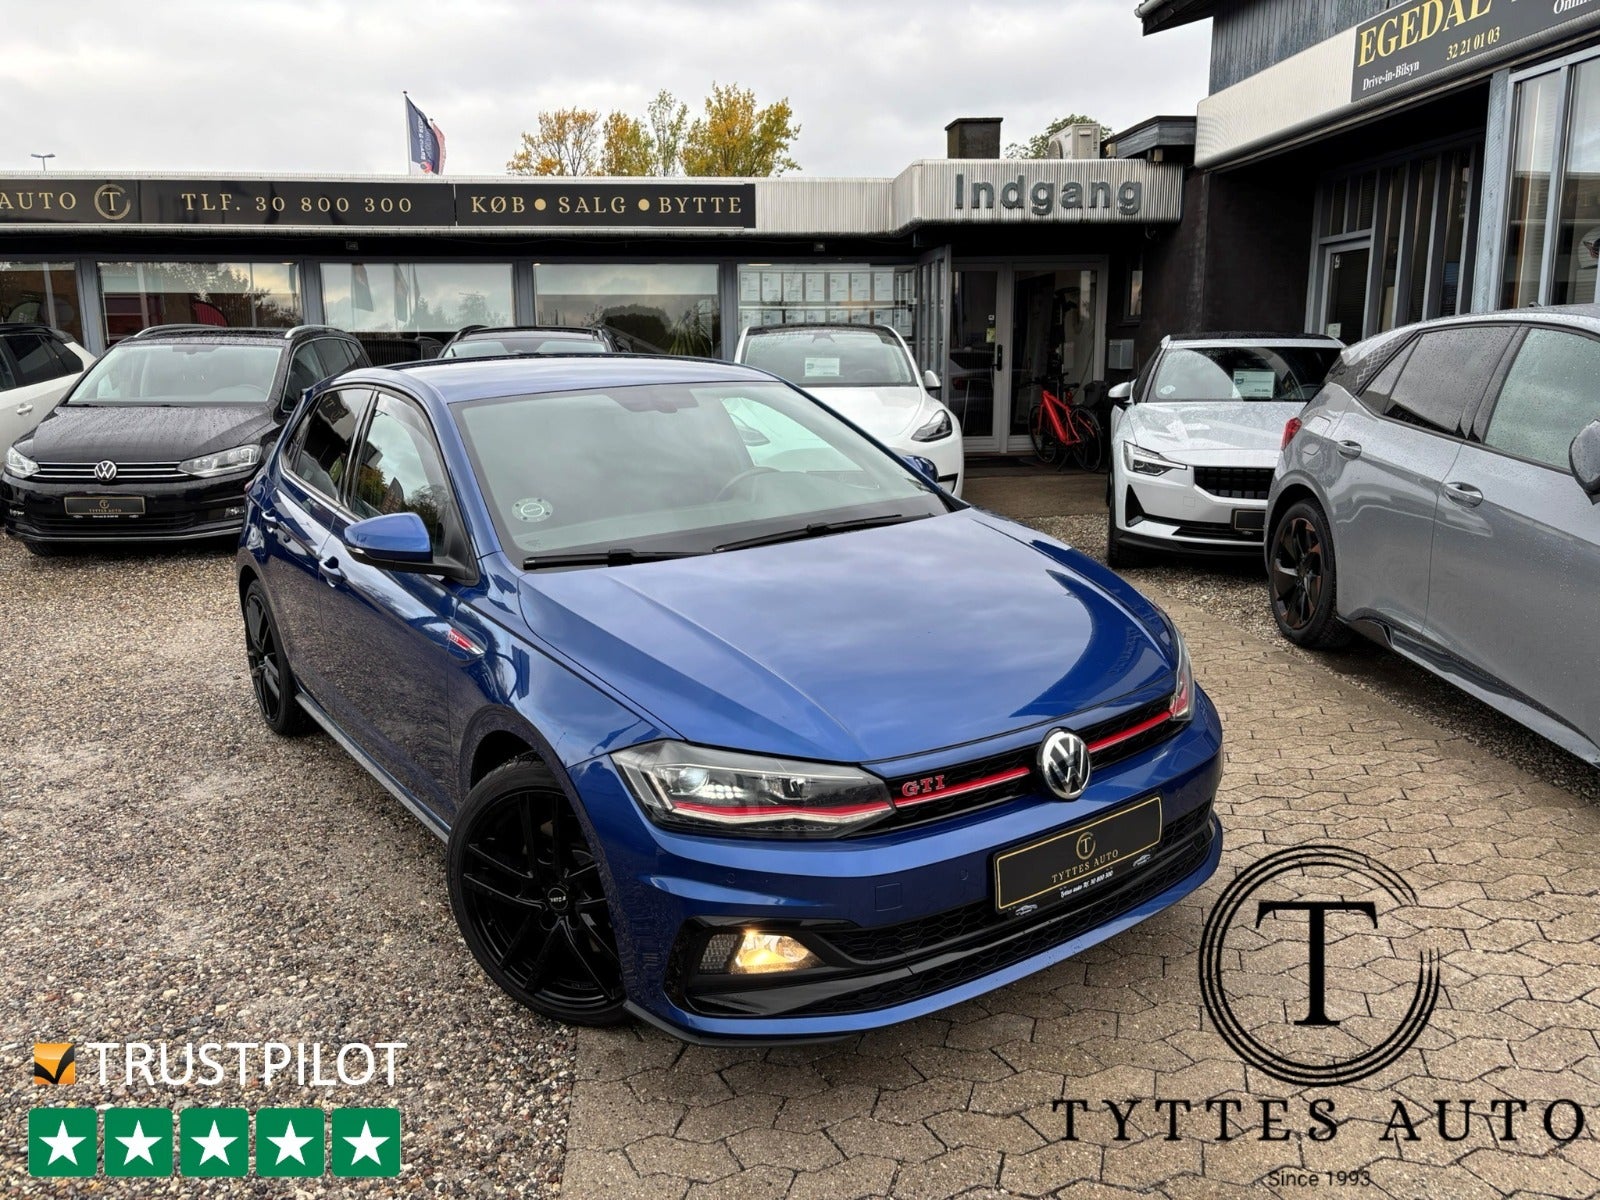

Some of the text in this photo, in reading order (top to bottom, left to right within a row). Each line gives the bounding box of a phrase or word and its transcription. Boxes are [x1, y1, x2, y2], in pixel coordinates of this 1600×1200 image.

[1358, 0, 1492, 68] EGEDAL
[1446, 26, 1500, 60] 32 21 01 03
[1362, 61, 1420, 91] Drive-in-Bilsyn
[0, 191, 77, 210] AUTO
[181, 193, 413, 213] TLF. 30 800 300
[471, 196, 743, 214] KØB SALG BYTTE
[955, 174, 1143, 216] Indgang
[902, 774, 946, 797] GTI
[1051, 849, 1119, 883] TYTTES AUTO
